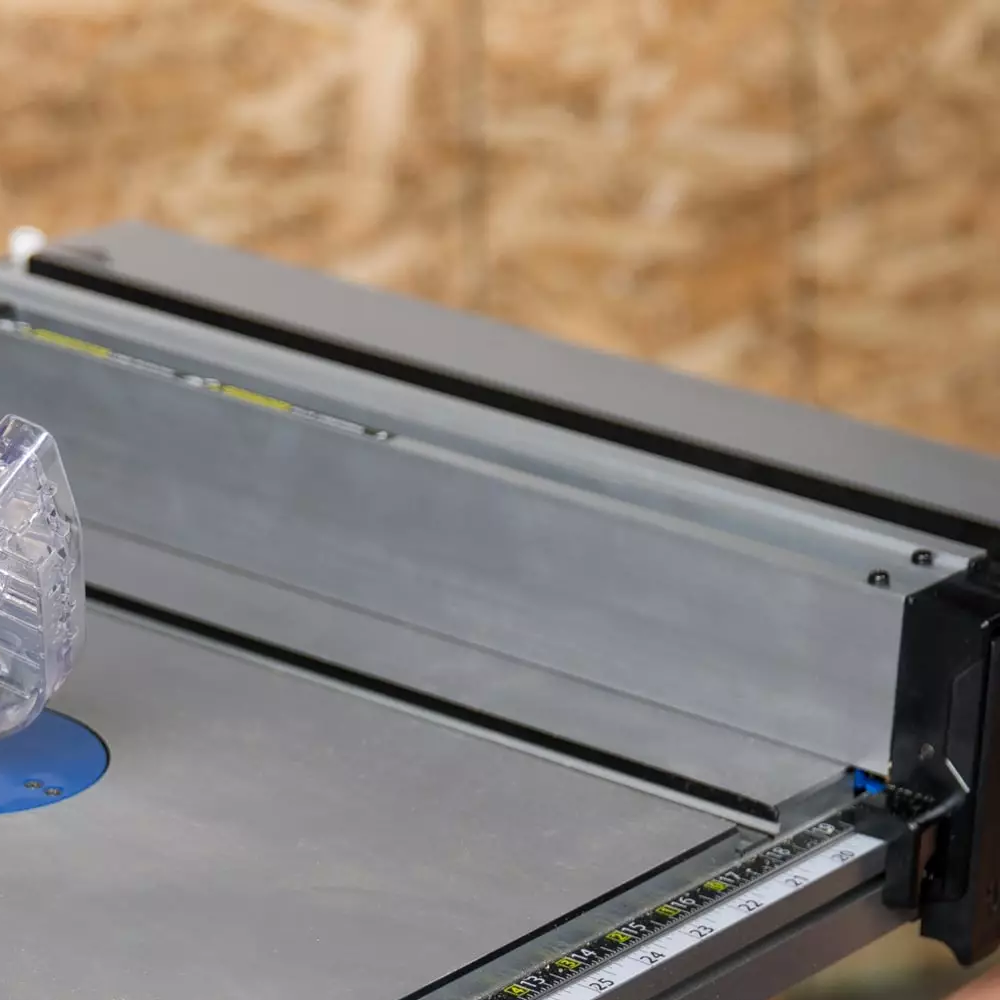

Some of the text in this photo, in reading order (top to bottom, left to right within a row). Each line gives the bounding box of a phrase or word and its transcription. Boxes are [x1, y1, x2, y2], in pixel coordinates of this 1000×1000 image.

[520, 975, 546, 988] 13
[571, 948, 597, 961] 14
[622, 921, 647, 935] 15
[671, 896, 696, 908] 16
[719, 871, 741, 883] 17
[589, 977, 615, 991] 25
[640, 950, 666, 964] 24
[689, 925, 714, 938] 23
[738, 899, 764, 912] 22
[785, 875, 809, 887] 21
[831, 850, 856, 864] 20
